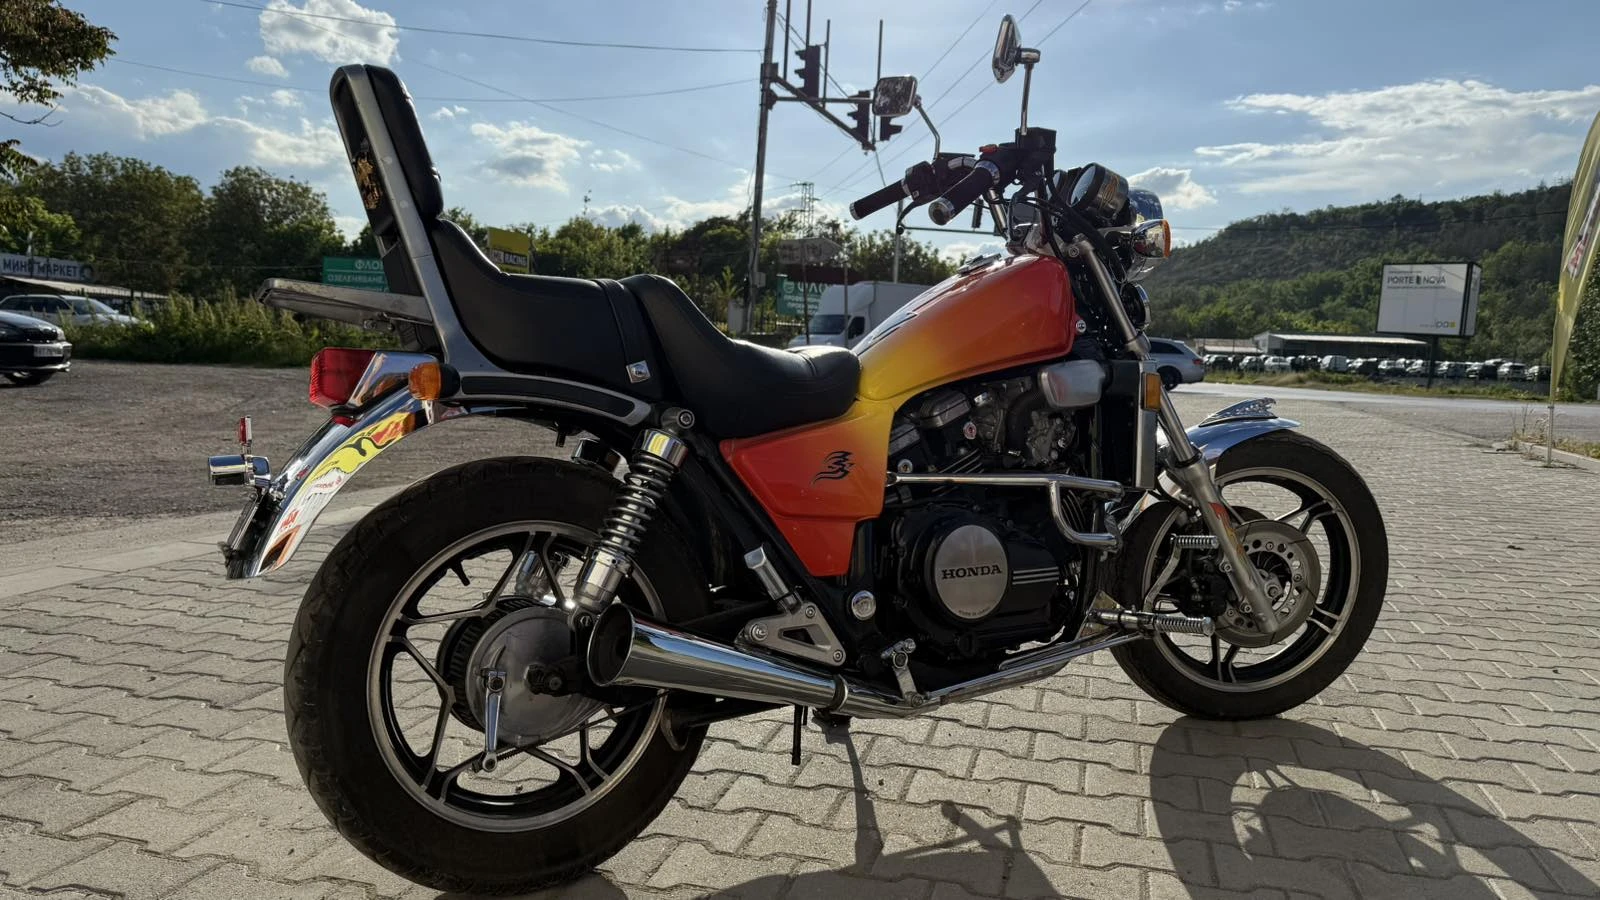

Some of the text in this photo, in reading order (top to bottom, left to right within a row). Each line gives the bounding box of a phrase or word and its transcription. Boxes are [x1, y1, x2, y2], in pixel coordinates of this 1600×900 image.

[354, 259, 384, 271] ФЛО
[1387, 275, 1446, 285] PORTE NOVA
[941, 564, 1002, 580] HONDA
